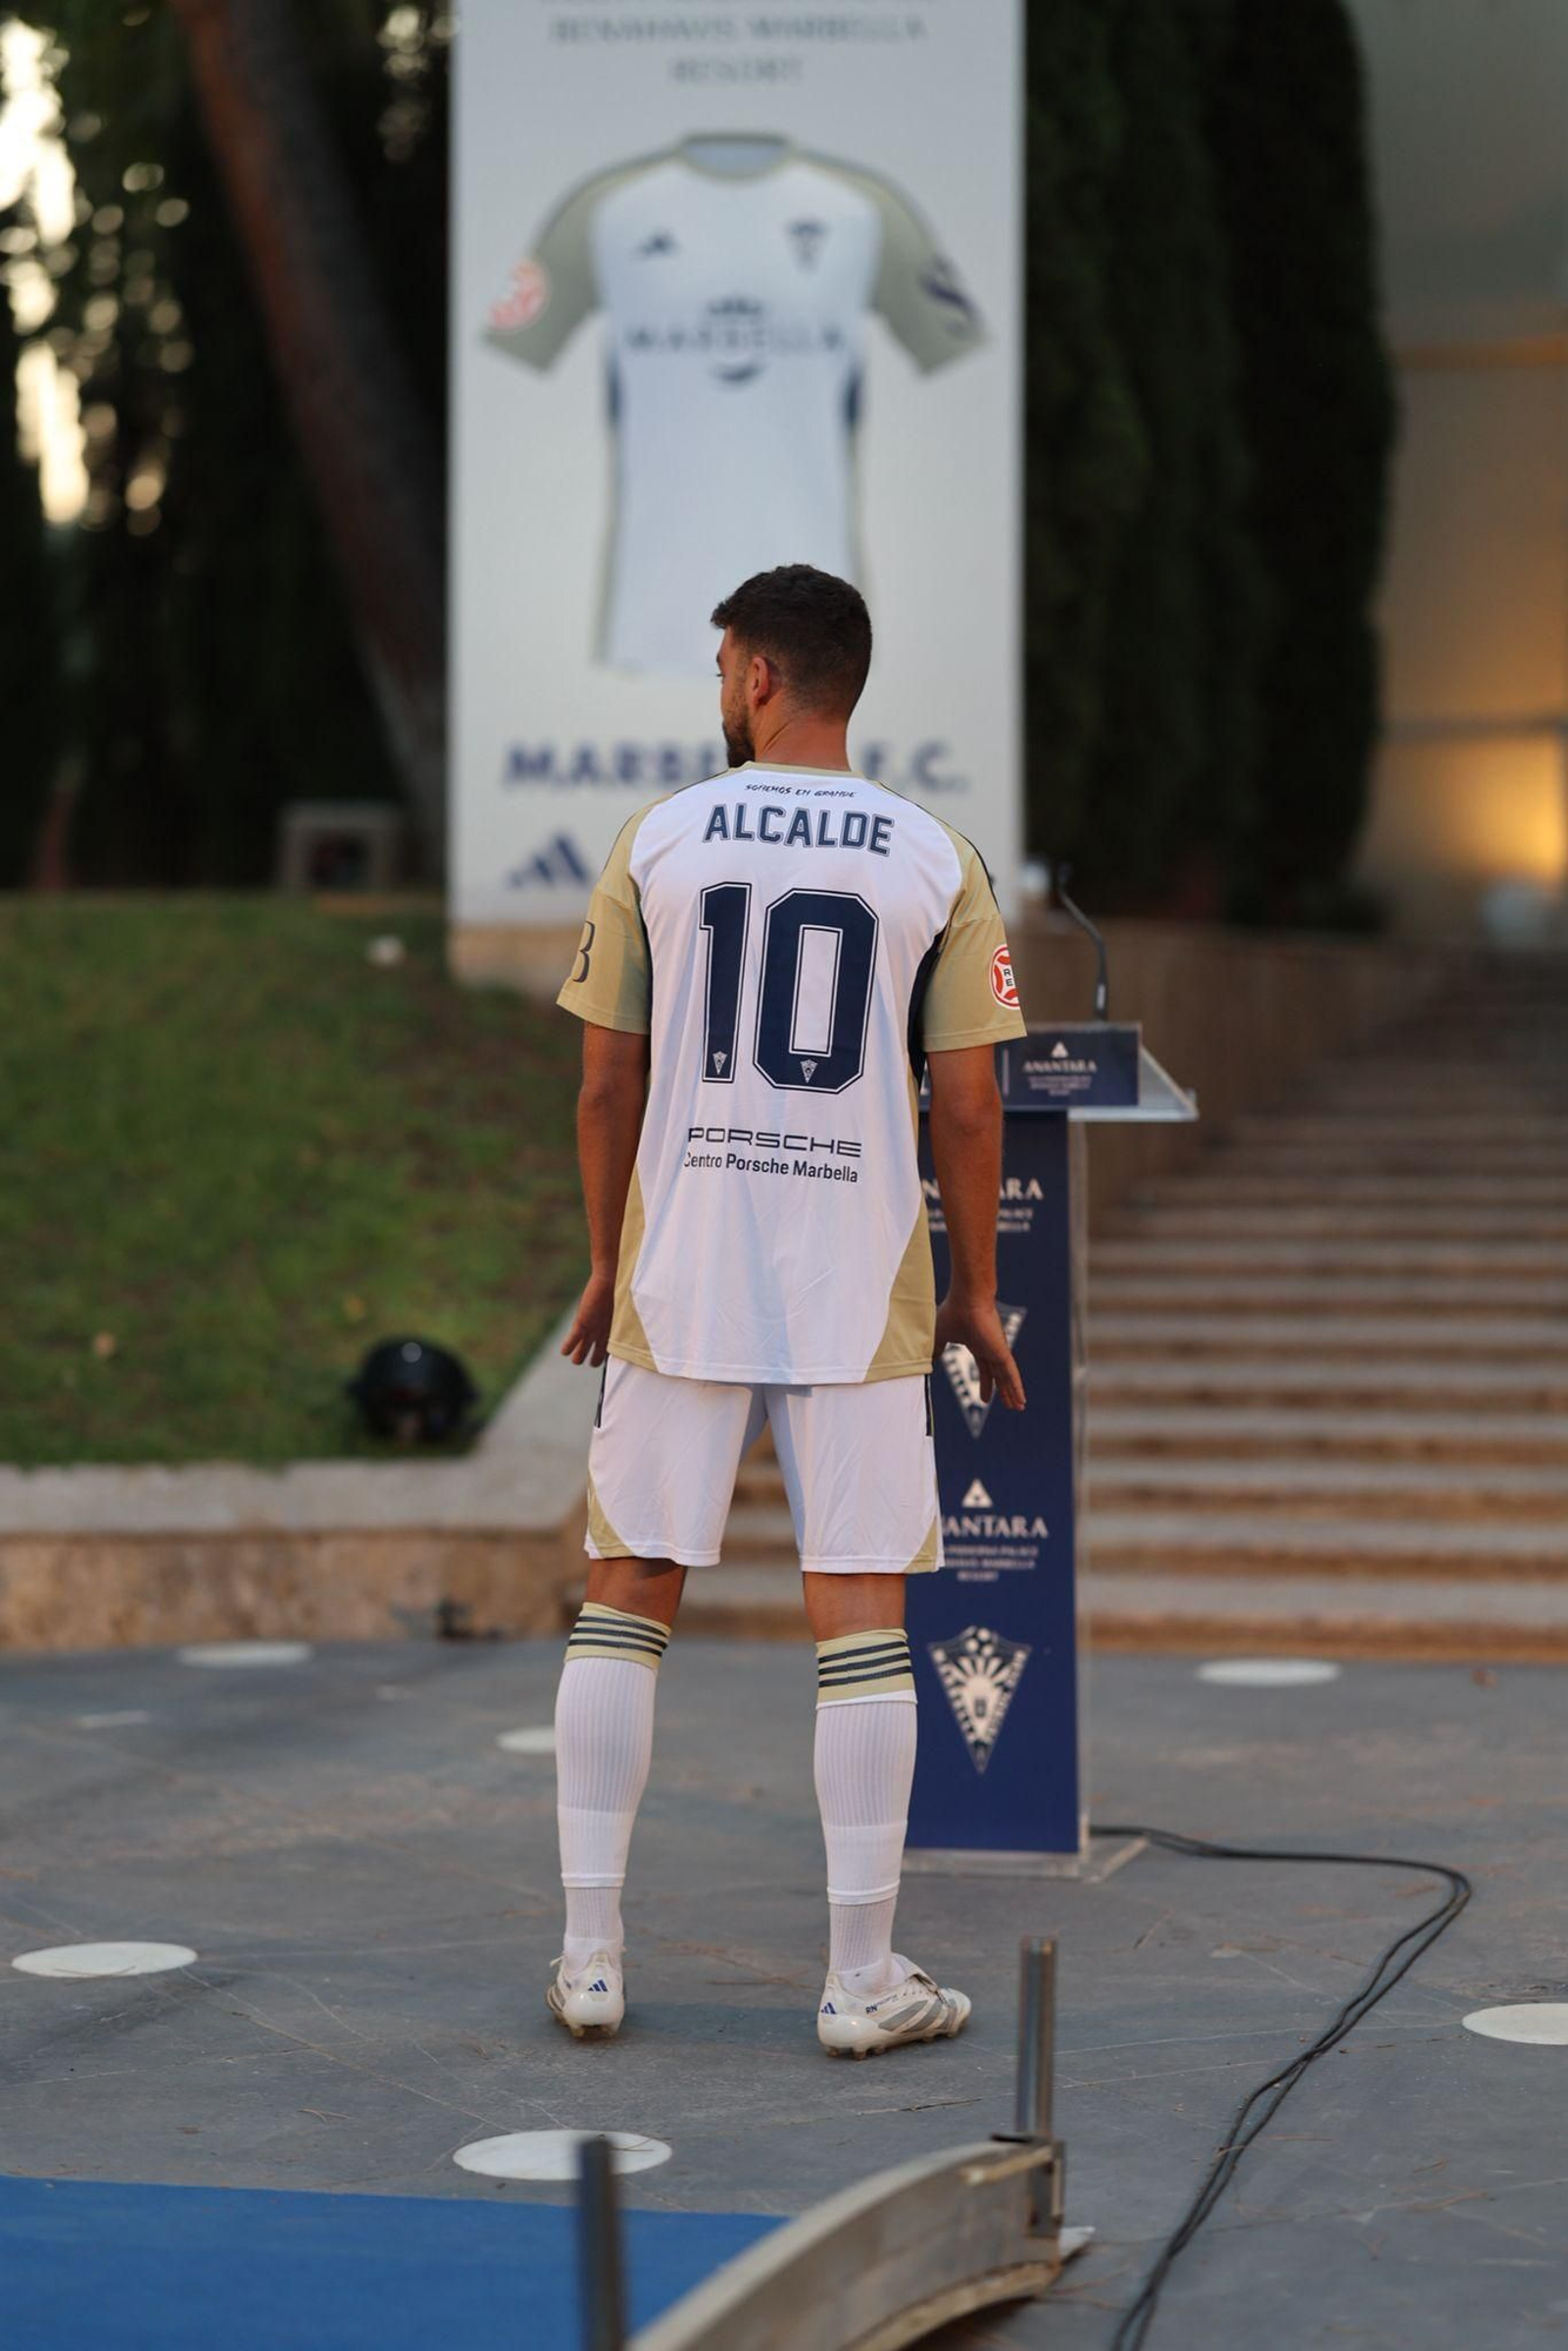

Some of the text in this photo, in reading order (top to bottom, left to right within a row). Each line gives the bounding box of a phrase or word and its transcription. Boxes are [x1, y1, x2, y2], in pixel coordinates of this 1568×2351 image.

[702, 802, 896, 857] ALCALDE
[699, 881, 879, 1095] 10
[688, 1127, 862, 1157] PORSCHE
[725, 1152, 790, 1175] Porsche
[792, 1160, 858, 1183] Marbella
